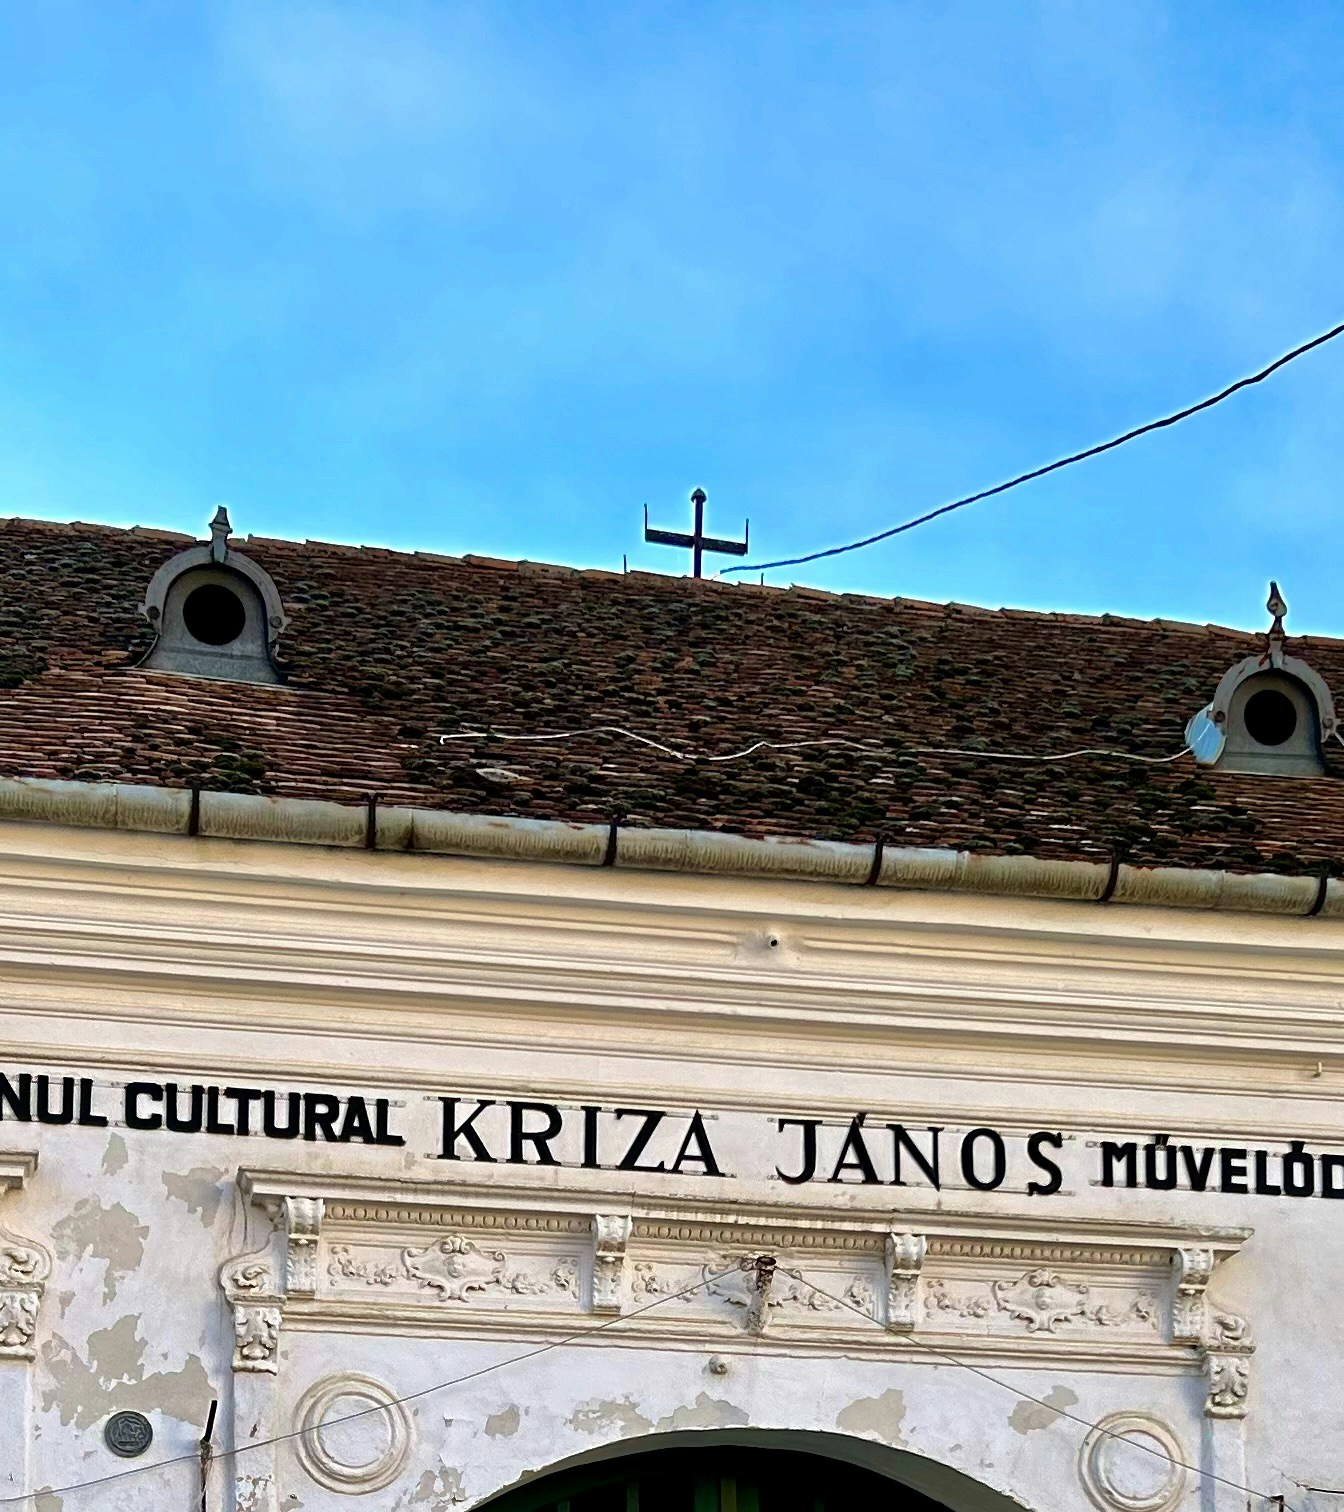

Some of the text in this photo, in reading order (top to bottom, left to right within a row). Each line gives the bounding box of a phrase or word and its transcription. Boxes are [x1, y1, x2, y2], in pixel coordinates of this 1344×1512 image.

[125, 1081, 406, 1146] CULTURAL
[437, 1096, 727, 1177] KRIZA
[775, 1113, 1063, 1196] JÁNOS
